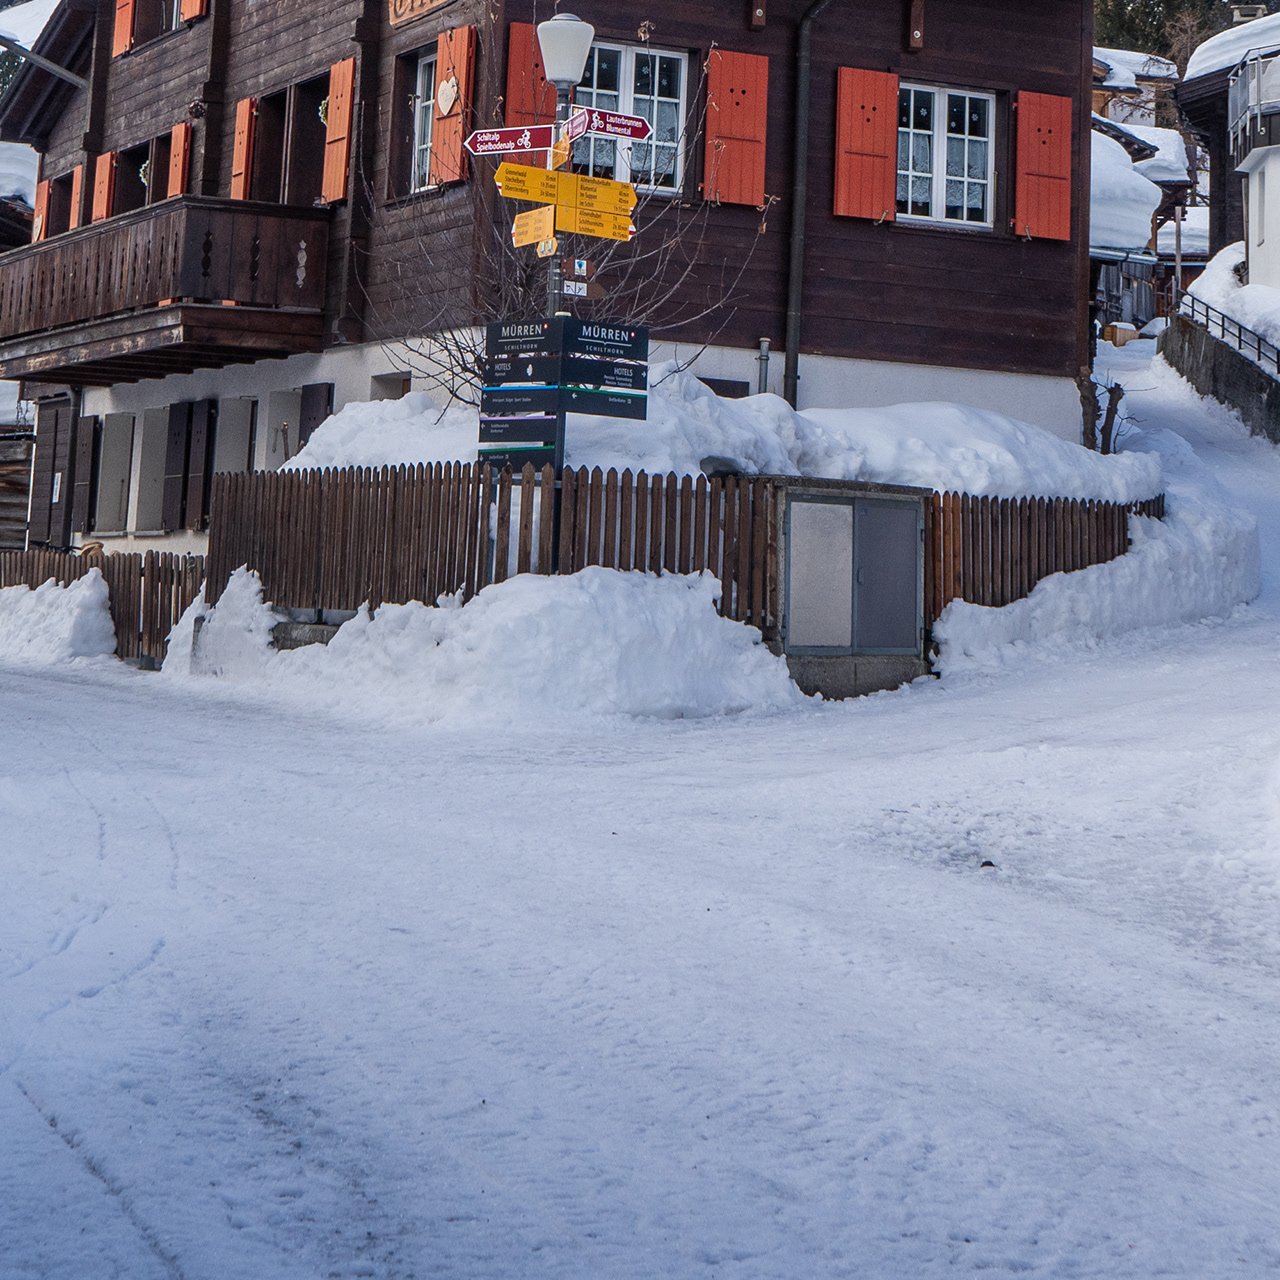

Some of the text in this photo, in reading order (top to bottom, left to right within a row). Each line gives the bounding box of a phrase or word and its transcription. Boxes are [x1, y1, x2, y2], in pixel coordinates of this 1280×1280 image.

[606, 114, 642, 128] Lauterbrunnen
[606, 123, 631, 135] Blumental
[477, 132, 500, 142] Schiltalp
[476, 140, 515, 152] Spielbodenalp
[501, 323, 542, 337] MÜRREN
[582, 325, 629, 342] MÜRREN
[504, 343, 538, 351] SCHILTHORN
[585, 345, 624, 355] SCHILTHORN
[495, 363, 511, 371] HOTELS
[614, 367, 633, 377] HOTELS
